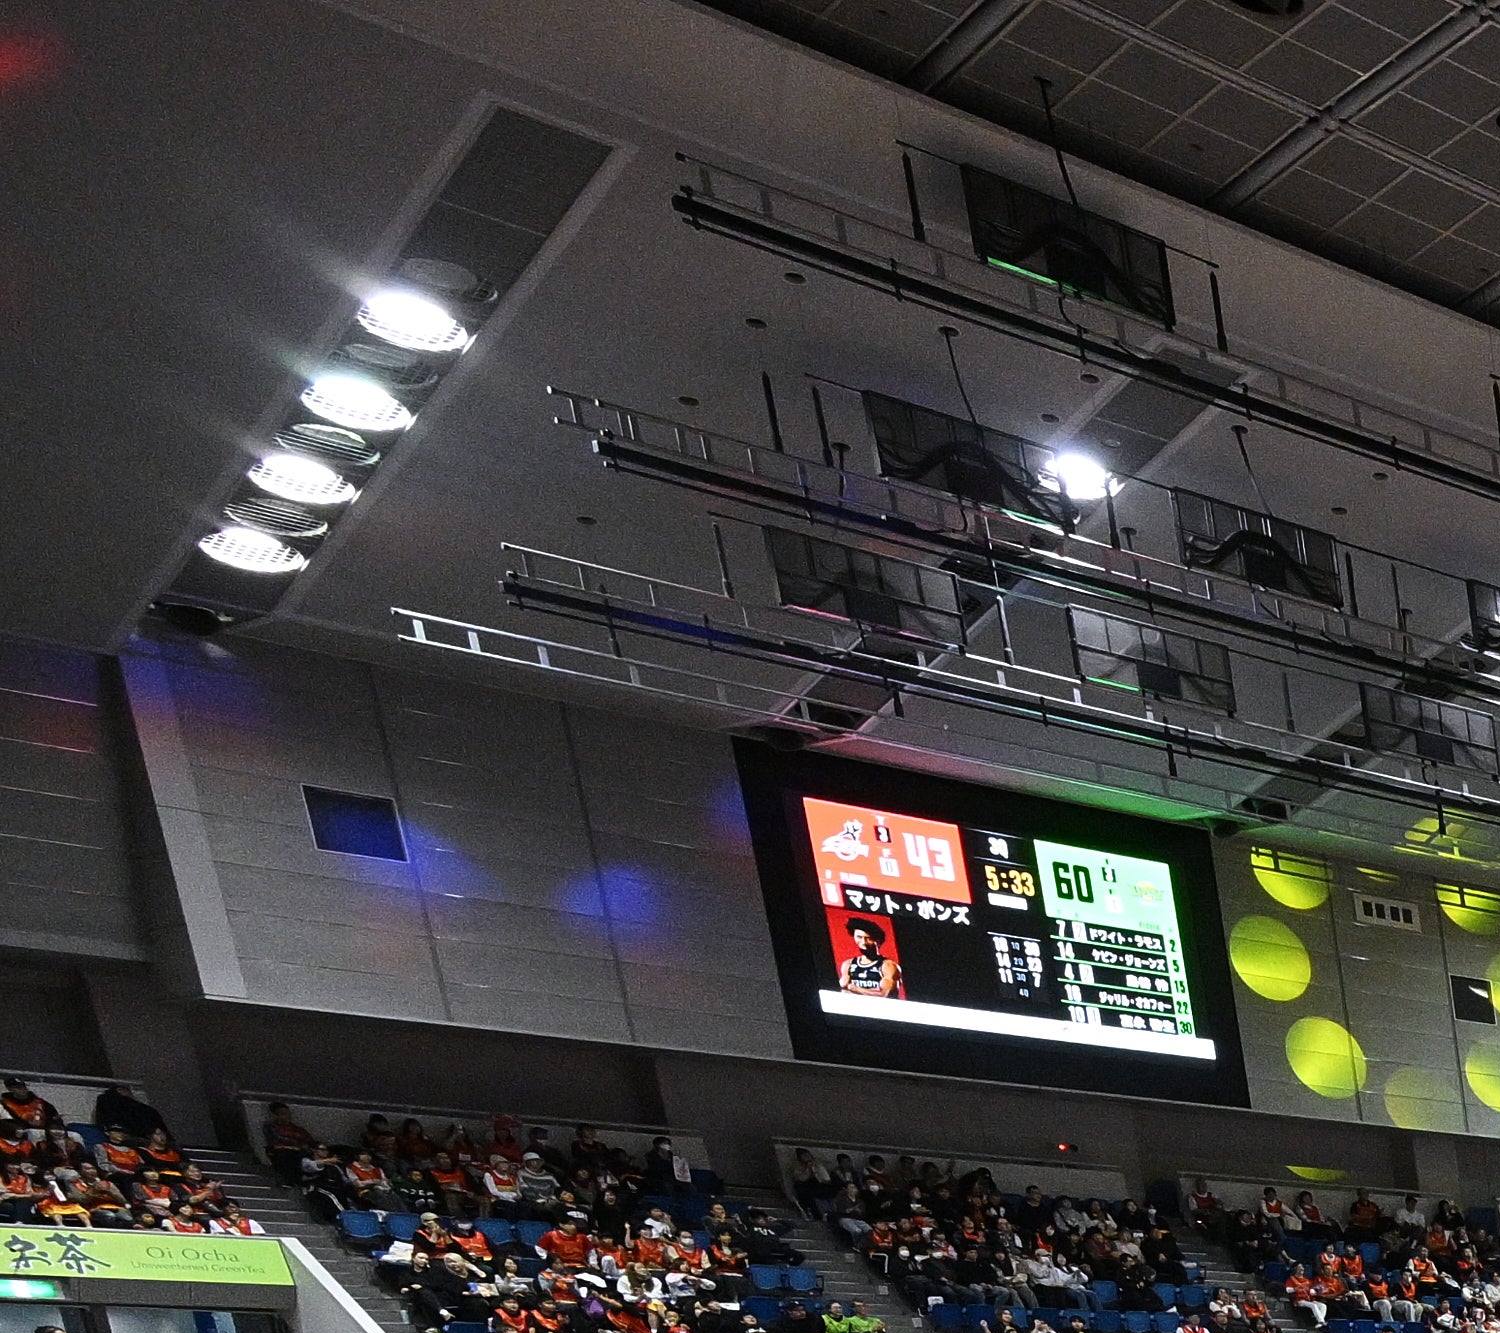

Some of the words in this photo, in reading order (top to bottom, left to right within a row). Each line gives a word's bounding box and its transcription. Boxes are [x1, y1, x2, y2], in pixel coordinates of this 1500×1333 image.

[903, 833, 955, 882] 43
[984, 865, 1034, 896] 5:33
[1052, 861, 1094, 902] 60
[146, 1246, 173, 1260] Oi
[181, 1248, 240, 1263] Ocha
